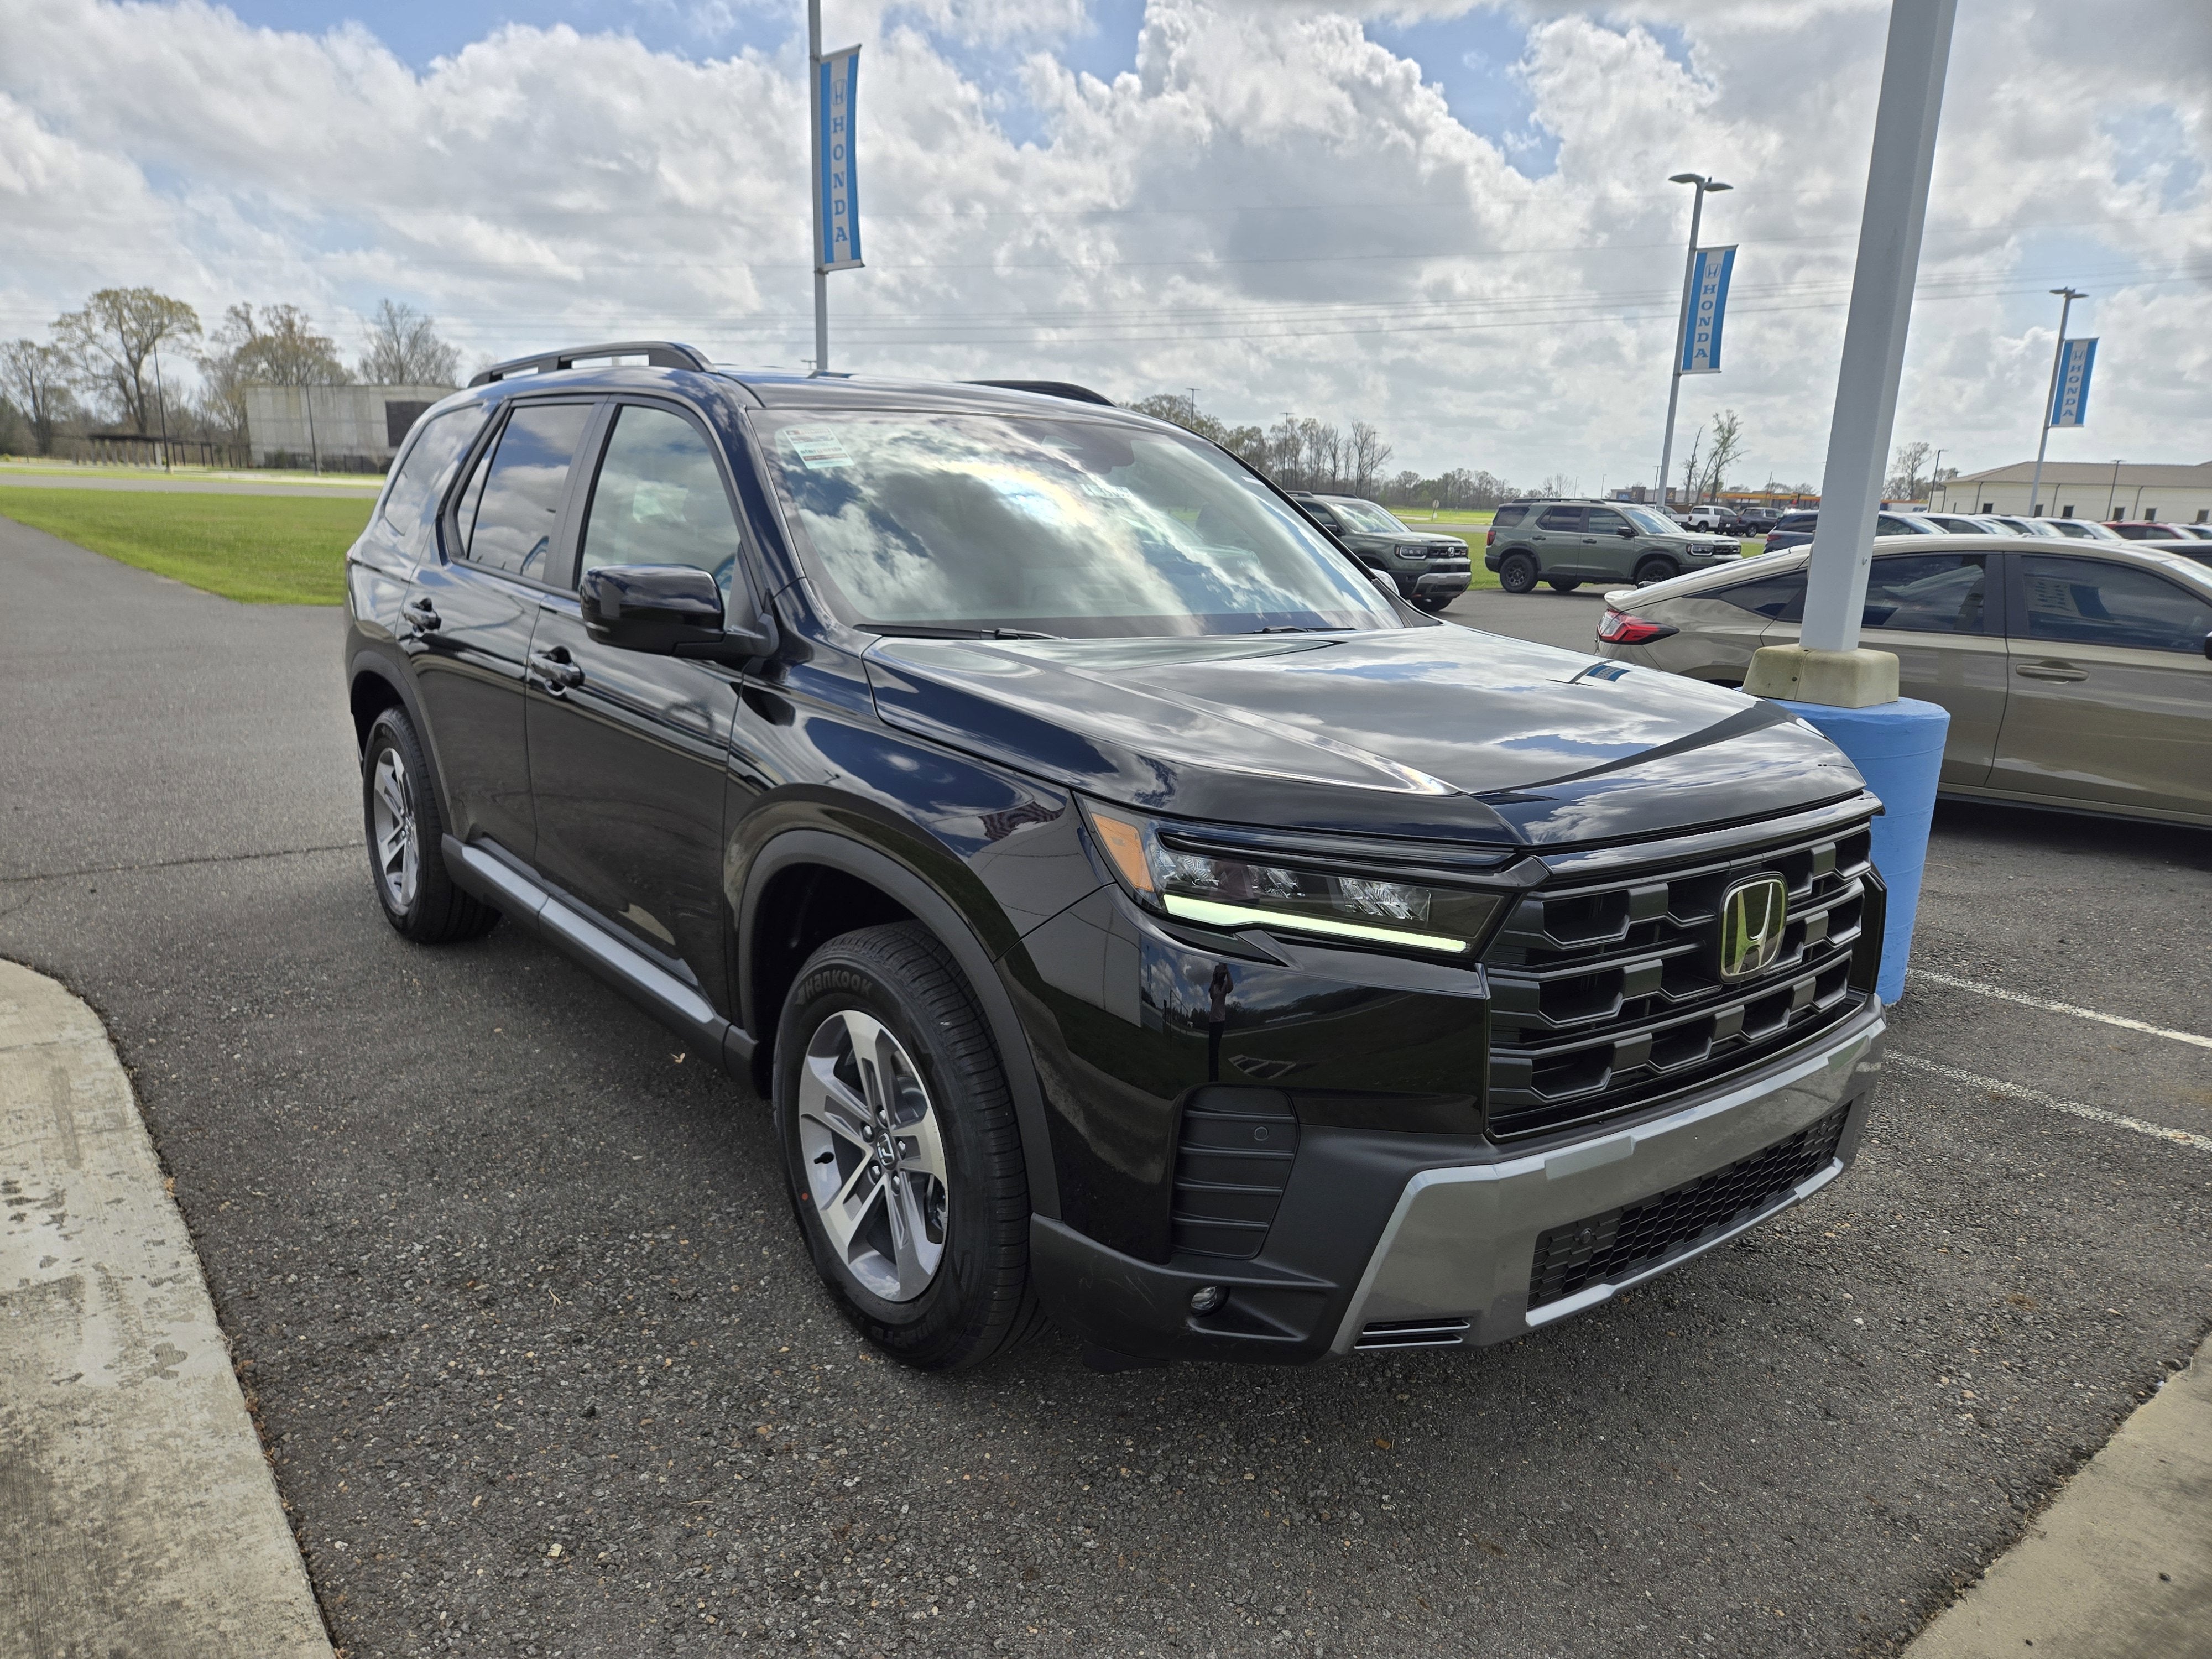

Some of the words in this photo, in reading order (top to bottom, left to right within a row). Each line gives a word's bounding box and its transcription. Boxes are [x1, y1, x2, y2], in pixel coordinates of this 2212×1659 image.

[832, 116, 848, 243] HONDA
[1694, 284, 1717, 358] HONDA
[2062, 364, 2082, 417] HONDA
